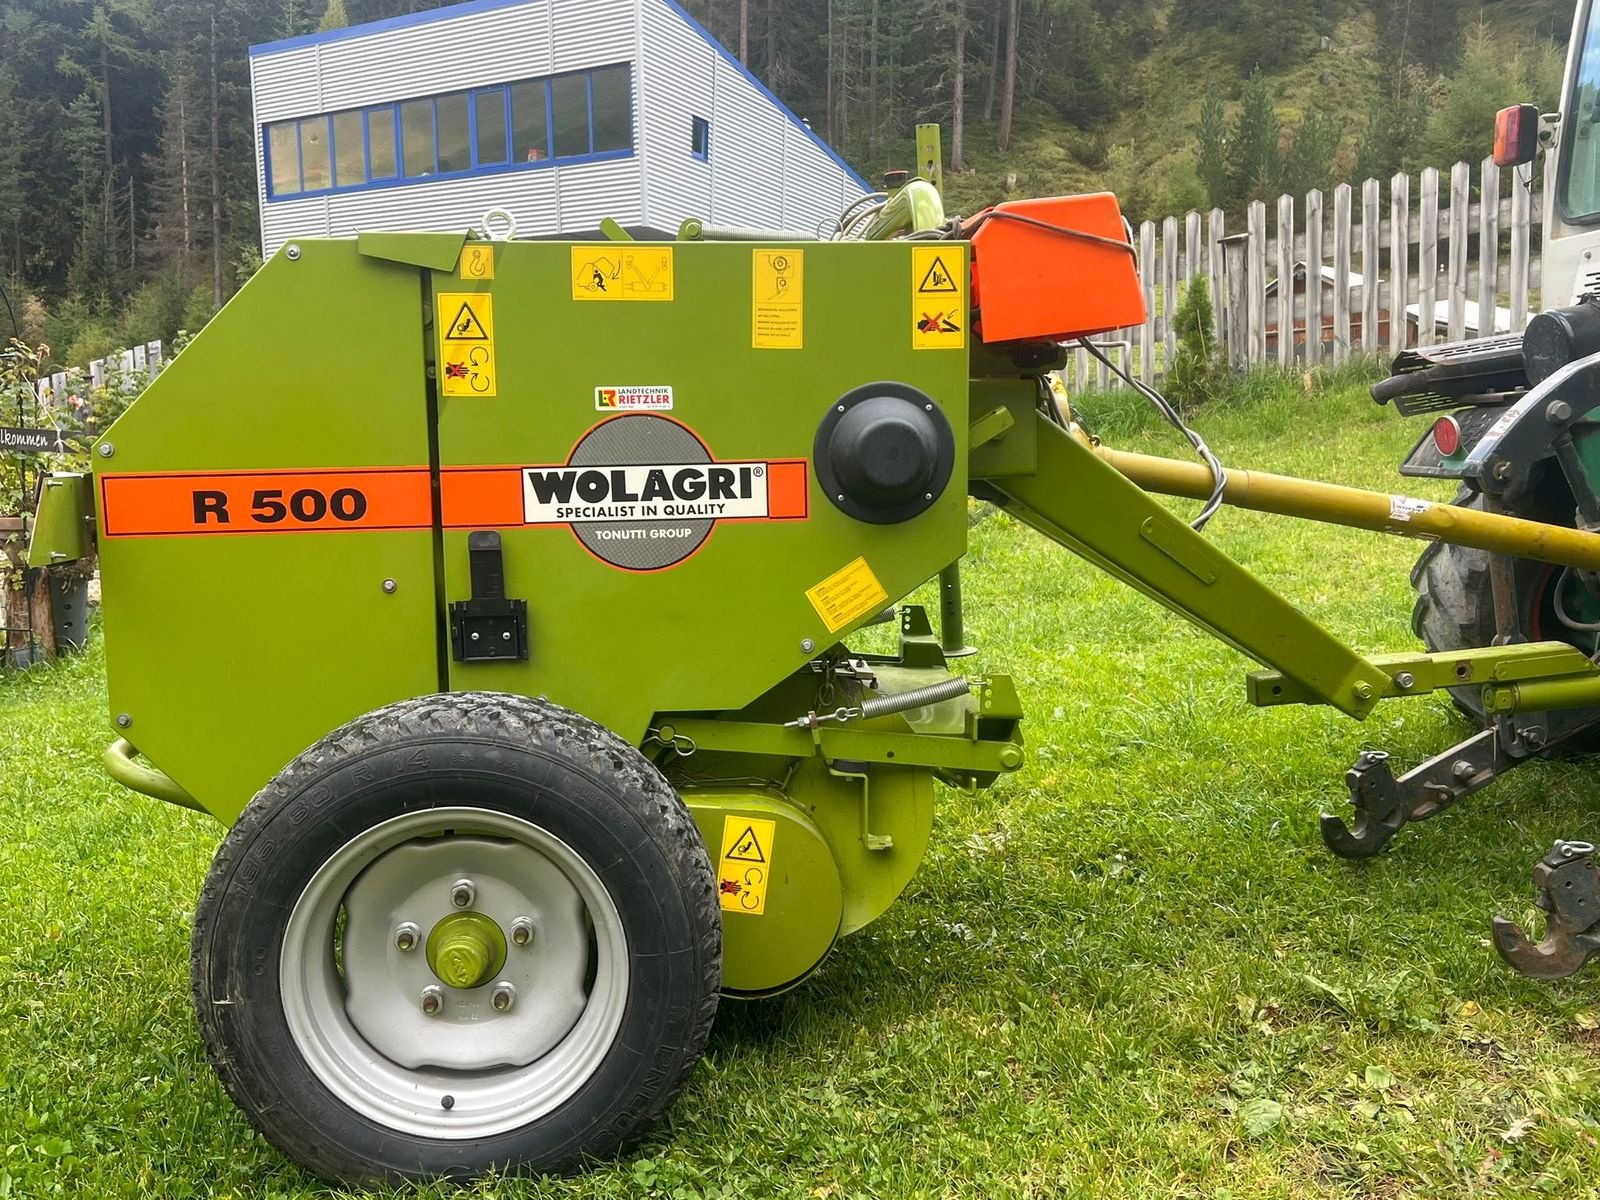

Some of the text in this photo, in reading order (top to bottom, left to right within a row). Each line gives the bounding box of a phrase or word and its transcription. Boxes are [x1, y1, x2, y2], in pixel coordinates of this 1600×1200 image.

[618, 394, 670, 405] RIETZLER
[192, 488, 367, 524] R 500
[556, 503, 726, 518] SPECIALIST IN QUALITY
[595, 528, 692, 540] TONUTTI GROUP
